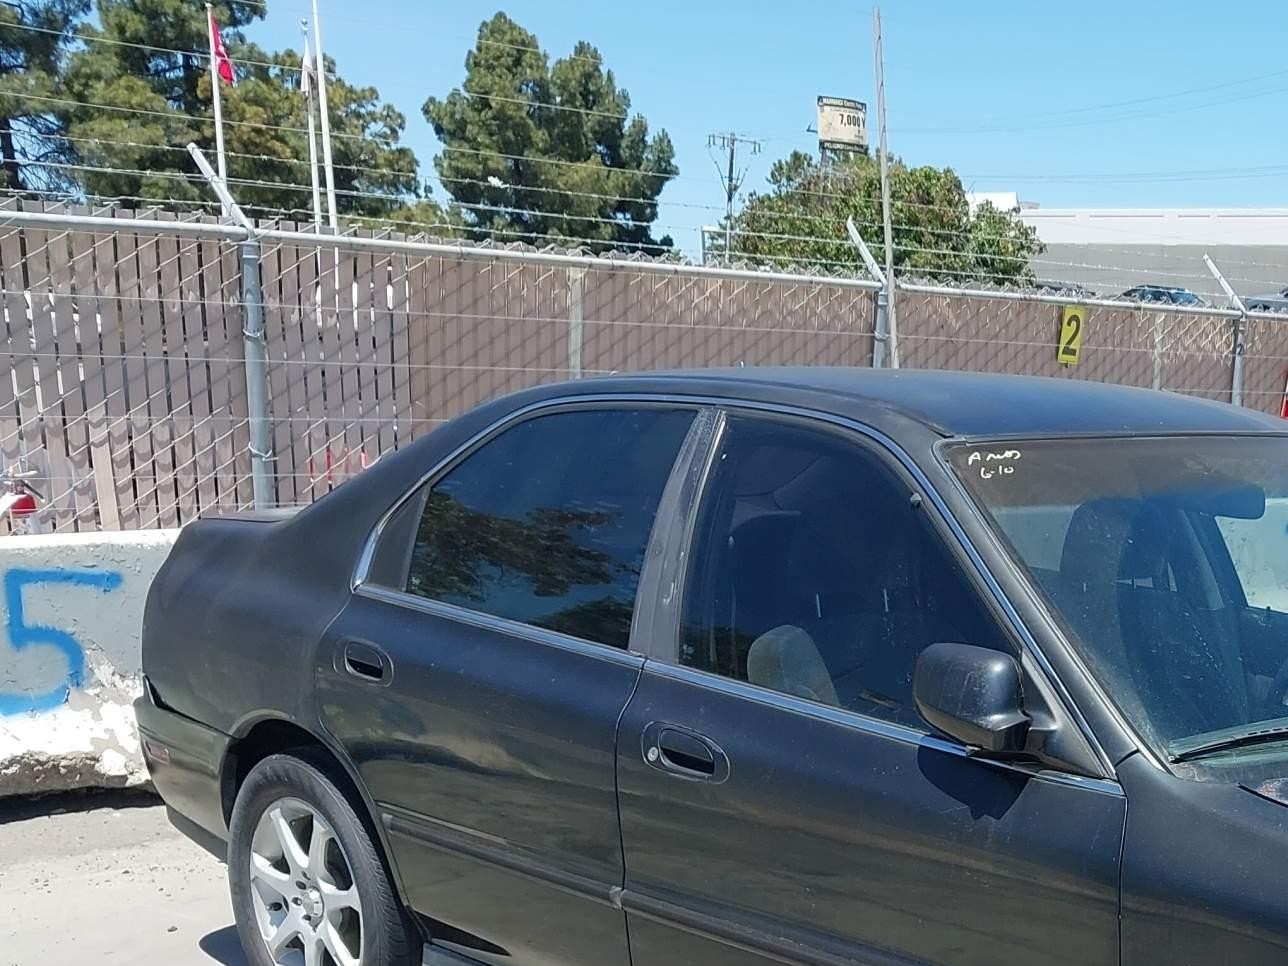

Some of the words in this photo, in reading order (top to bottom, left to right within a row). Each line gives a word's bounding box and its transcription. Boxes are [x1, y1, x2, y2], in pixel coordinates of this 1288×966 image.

[839, 113, 861, 128] 7,000
[1061, 314, 1081, 356] 2
[981, 465, 1014, 479] 6-10
[0, 567, 123, 716] 5
